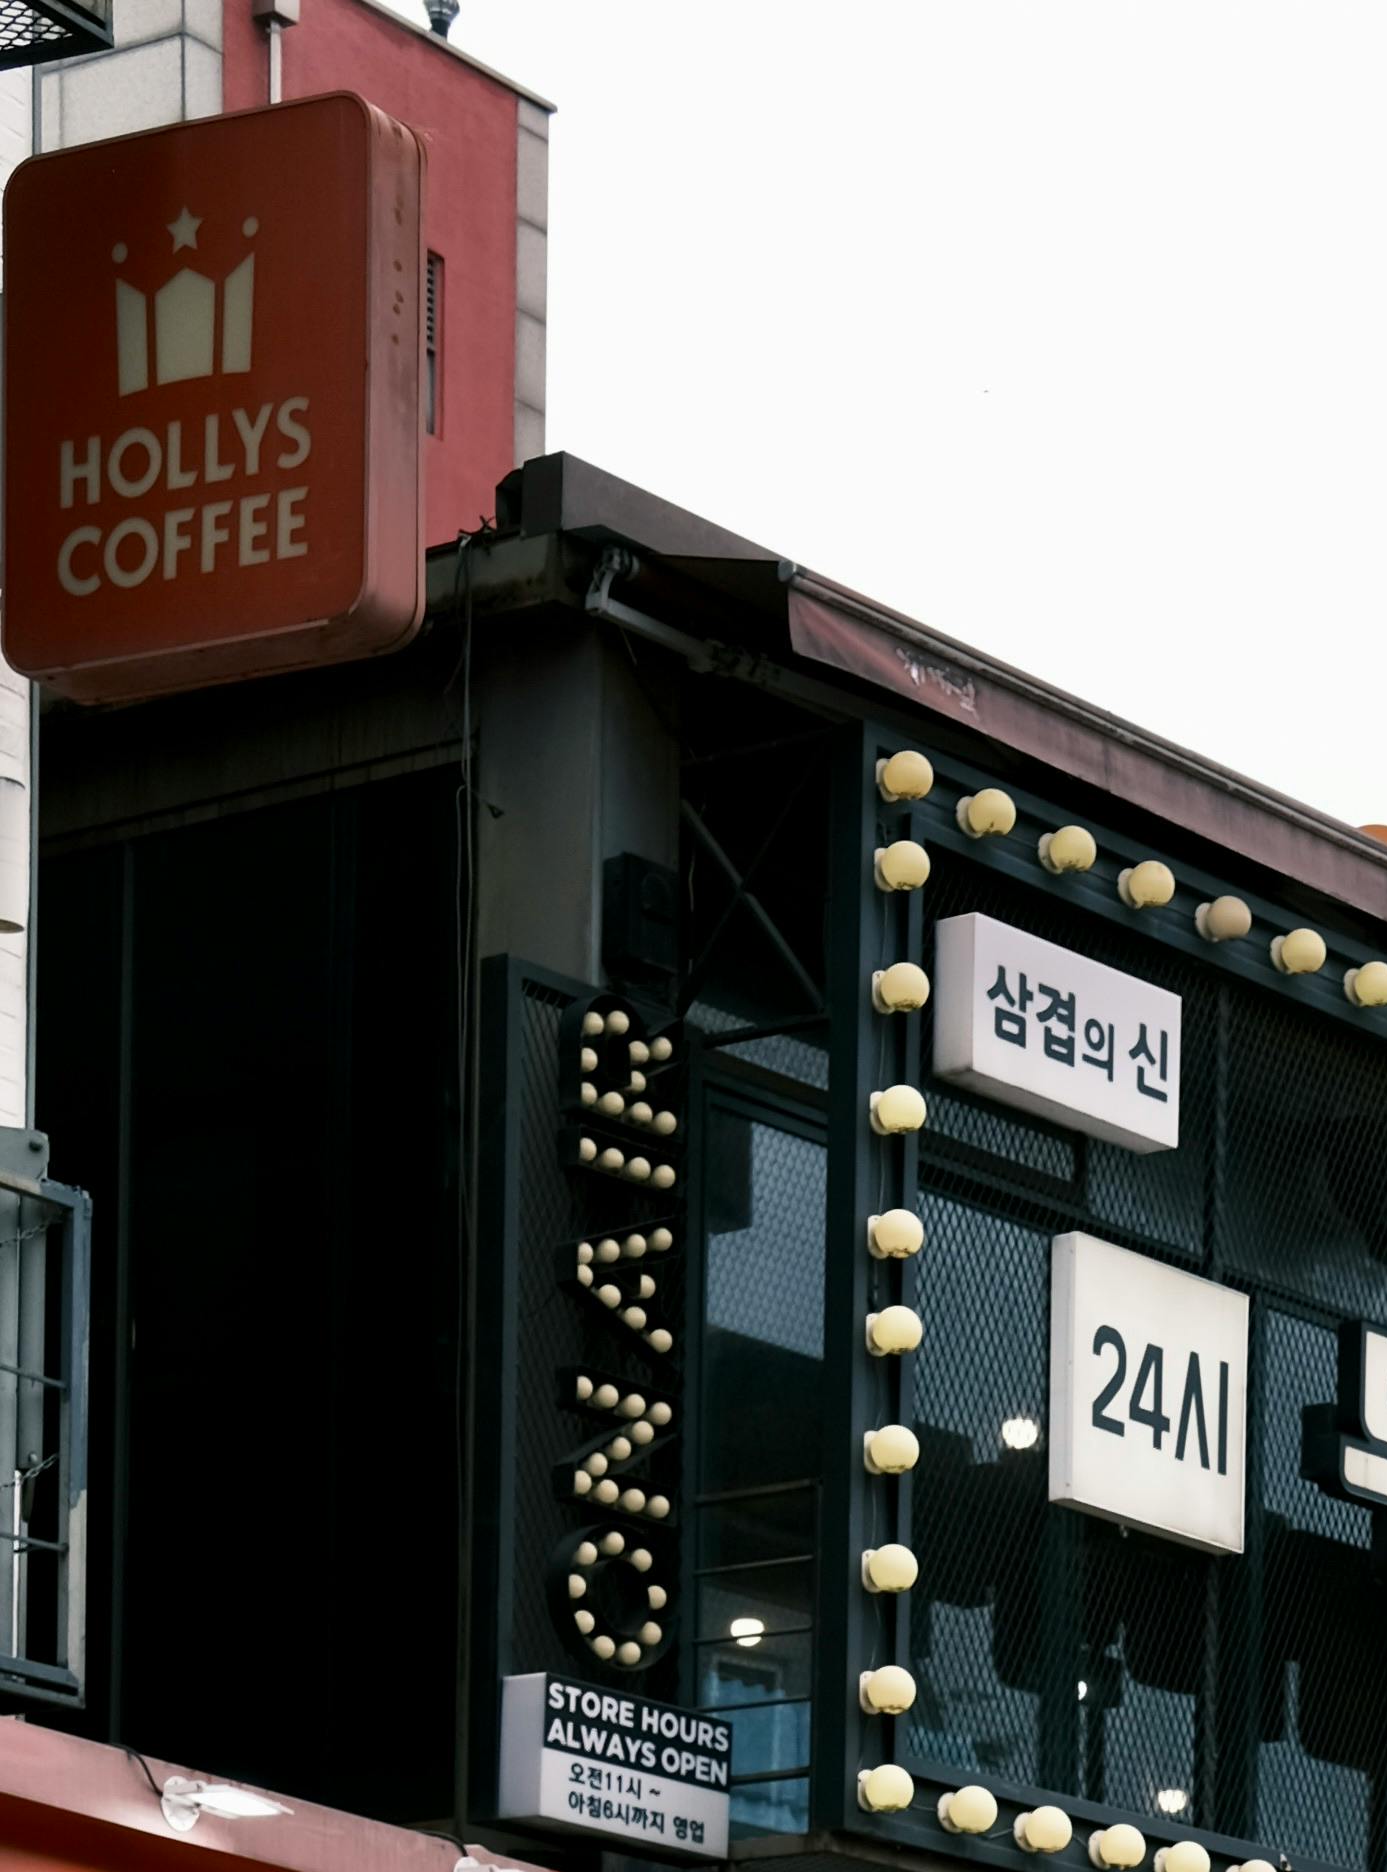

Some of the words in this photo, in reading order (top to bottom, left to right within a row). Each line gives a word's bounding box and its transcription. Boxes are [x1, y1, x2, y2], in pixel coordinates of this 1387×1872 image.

[59, 396, 312, 509] HOLLYS
[56, 486, 310, 597] COFFEE
[985, 964, 1114, 1083] 삼겹의
[1129, 1021, 1169, 1103] 신
[1092, 1323, 1229, 1477] 24시
[546, 1717, 656, 1769] ALWAYS
[660, 1746, 728, 1788] OPEN
[548, 1682, 635, 1728] STORE
[641, 1706, 730, 1752] HOURS
[567, 1761, 643, 1801] 오전11시
[567, 1790, 666, 1836] 아침6시까지
[672, 1816, 706, 1845] 영업
